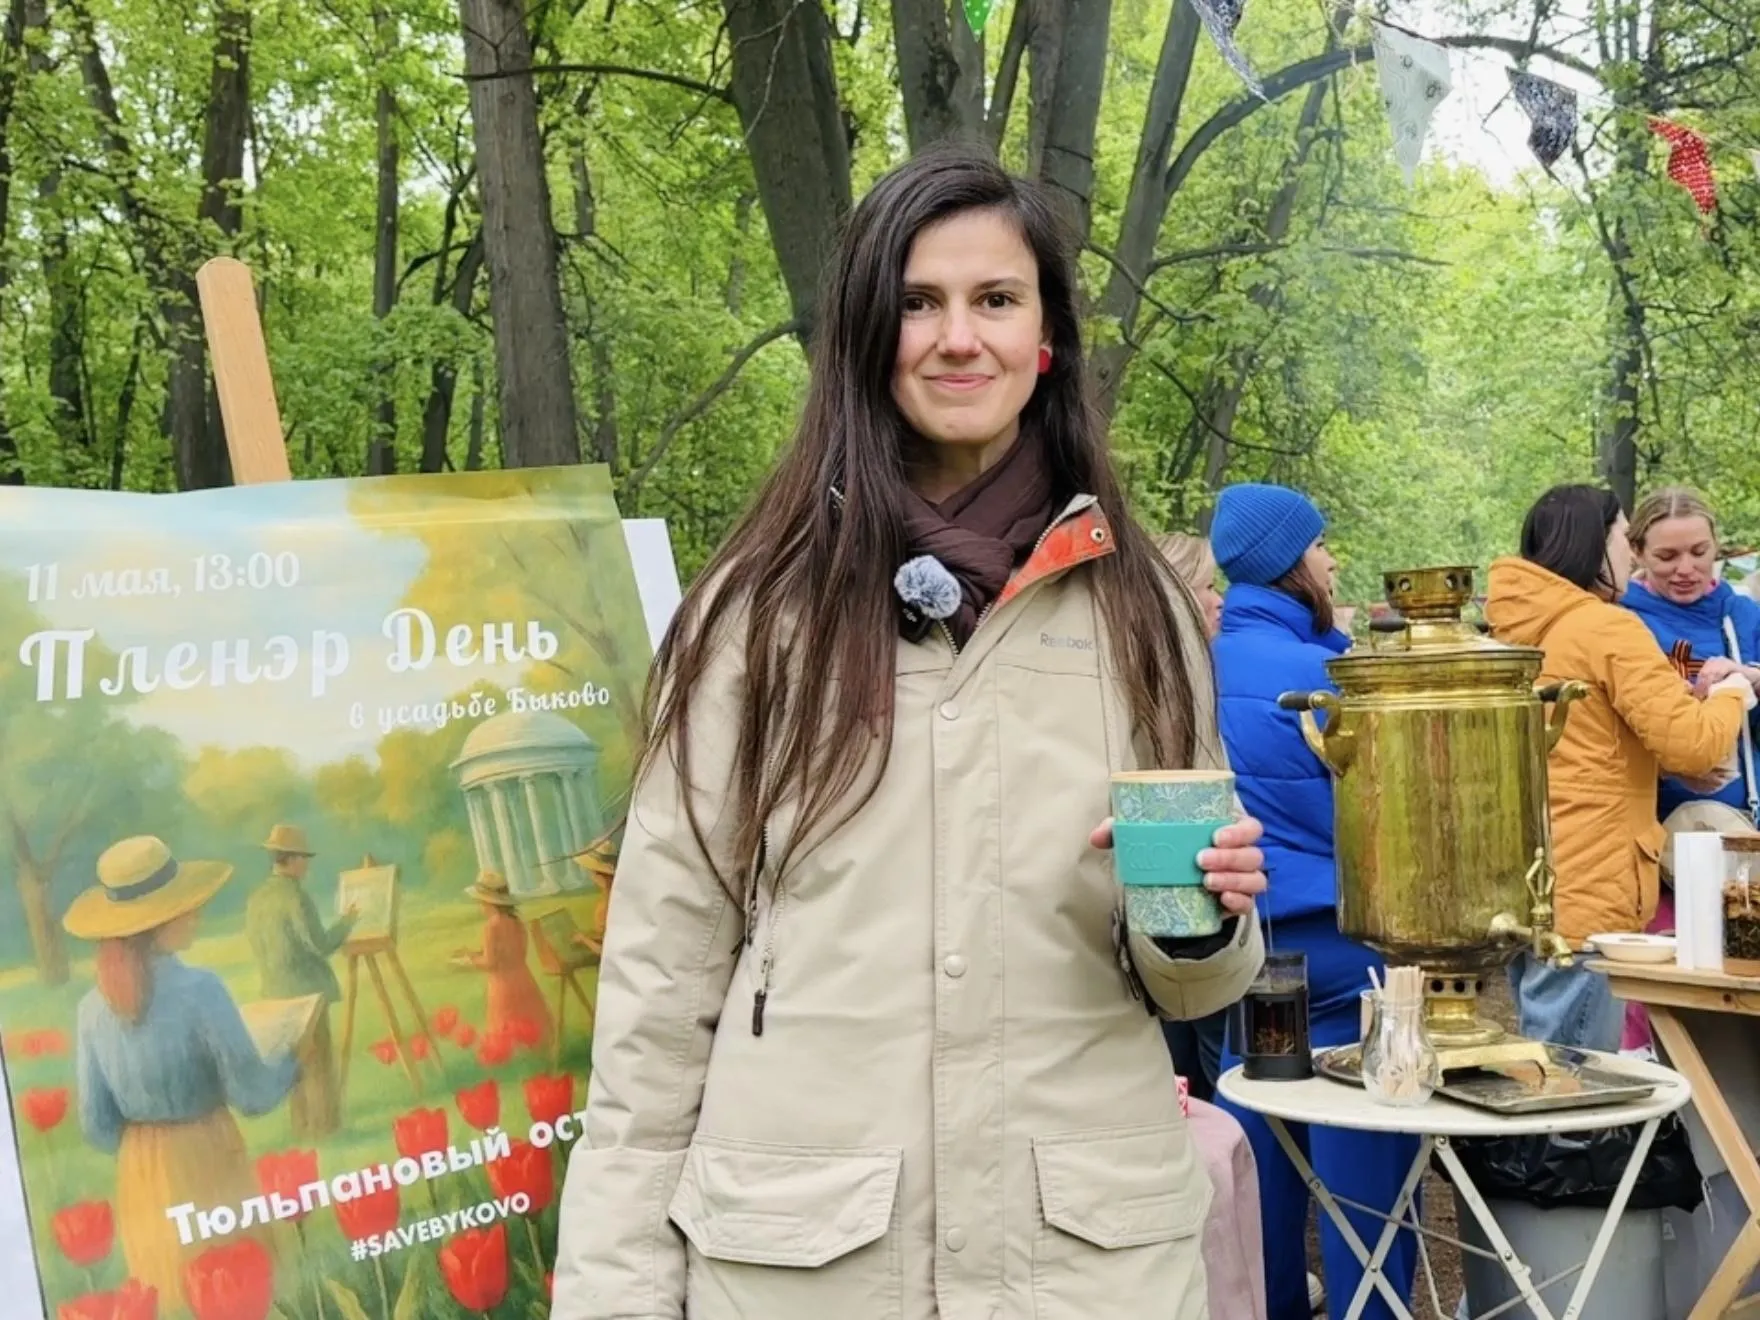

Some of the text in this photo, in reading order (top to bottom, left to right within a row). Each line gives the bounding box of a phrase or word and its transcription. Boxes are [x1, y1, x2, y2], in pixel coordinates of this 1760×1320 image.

[26, 551, 300, 602] 11 мая, 13:00
[19, 607, 559, 702] Пленэр День
[349, 681, 611, 734] в усадьбе Быково
[166, 1126, 512, 1245] Тюльпановый
[350, 1191, 531, 1262] #SAVEBYKOVO
